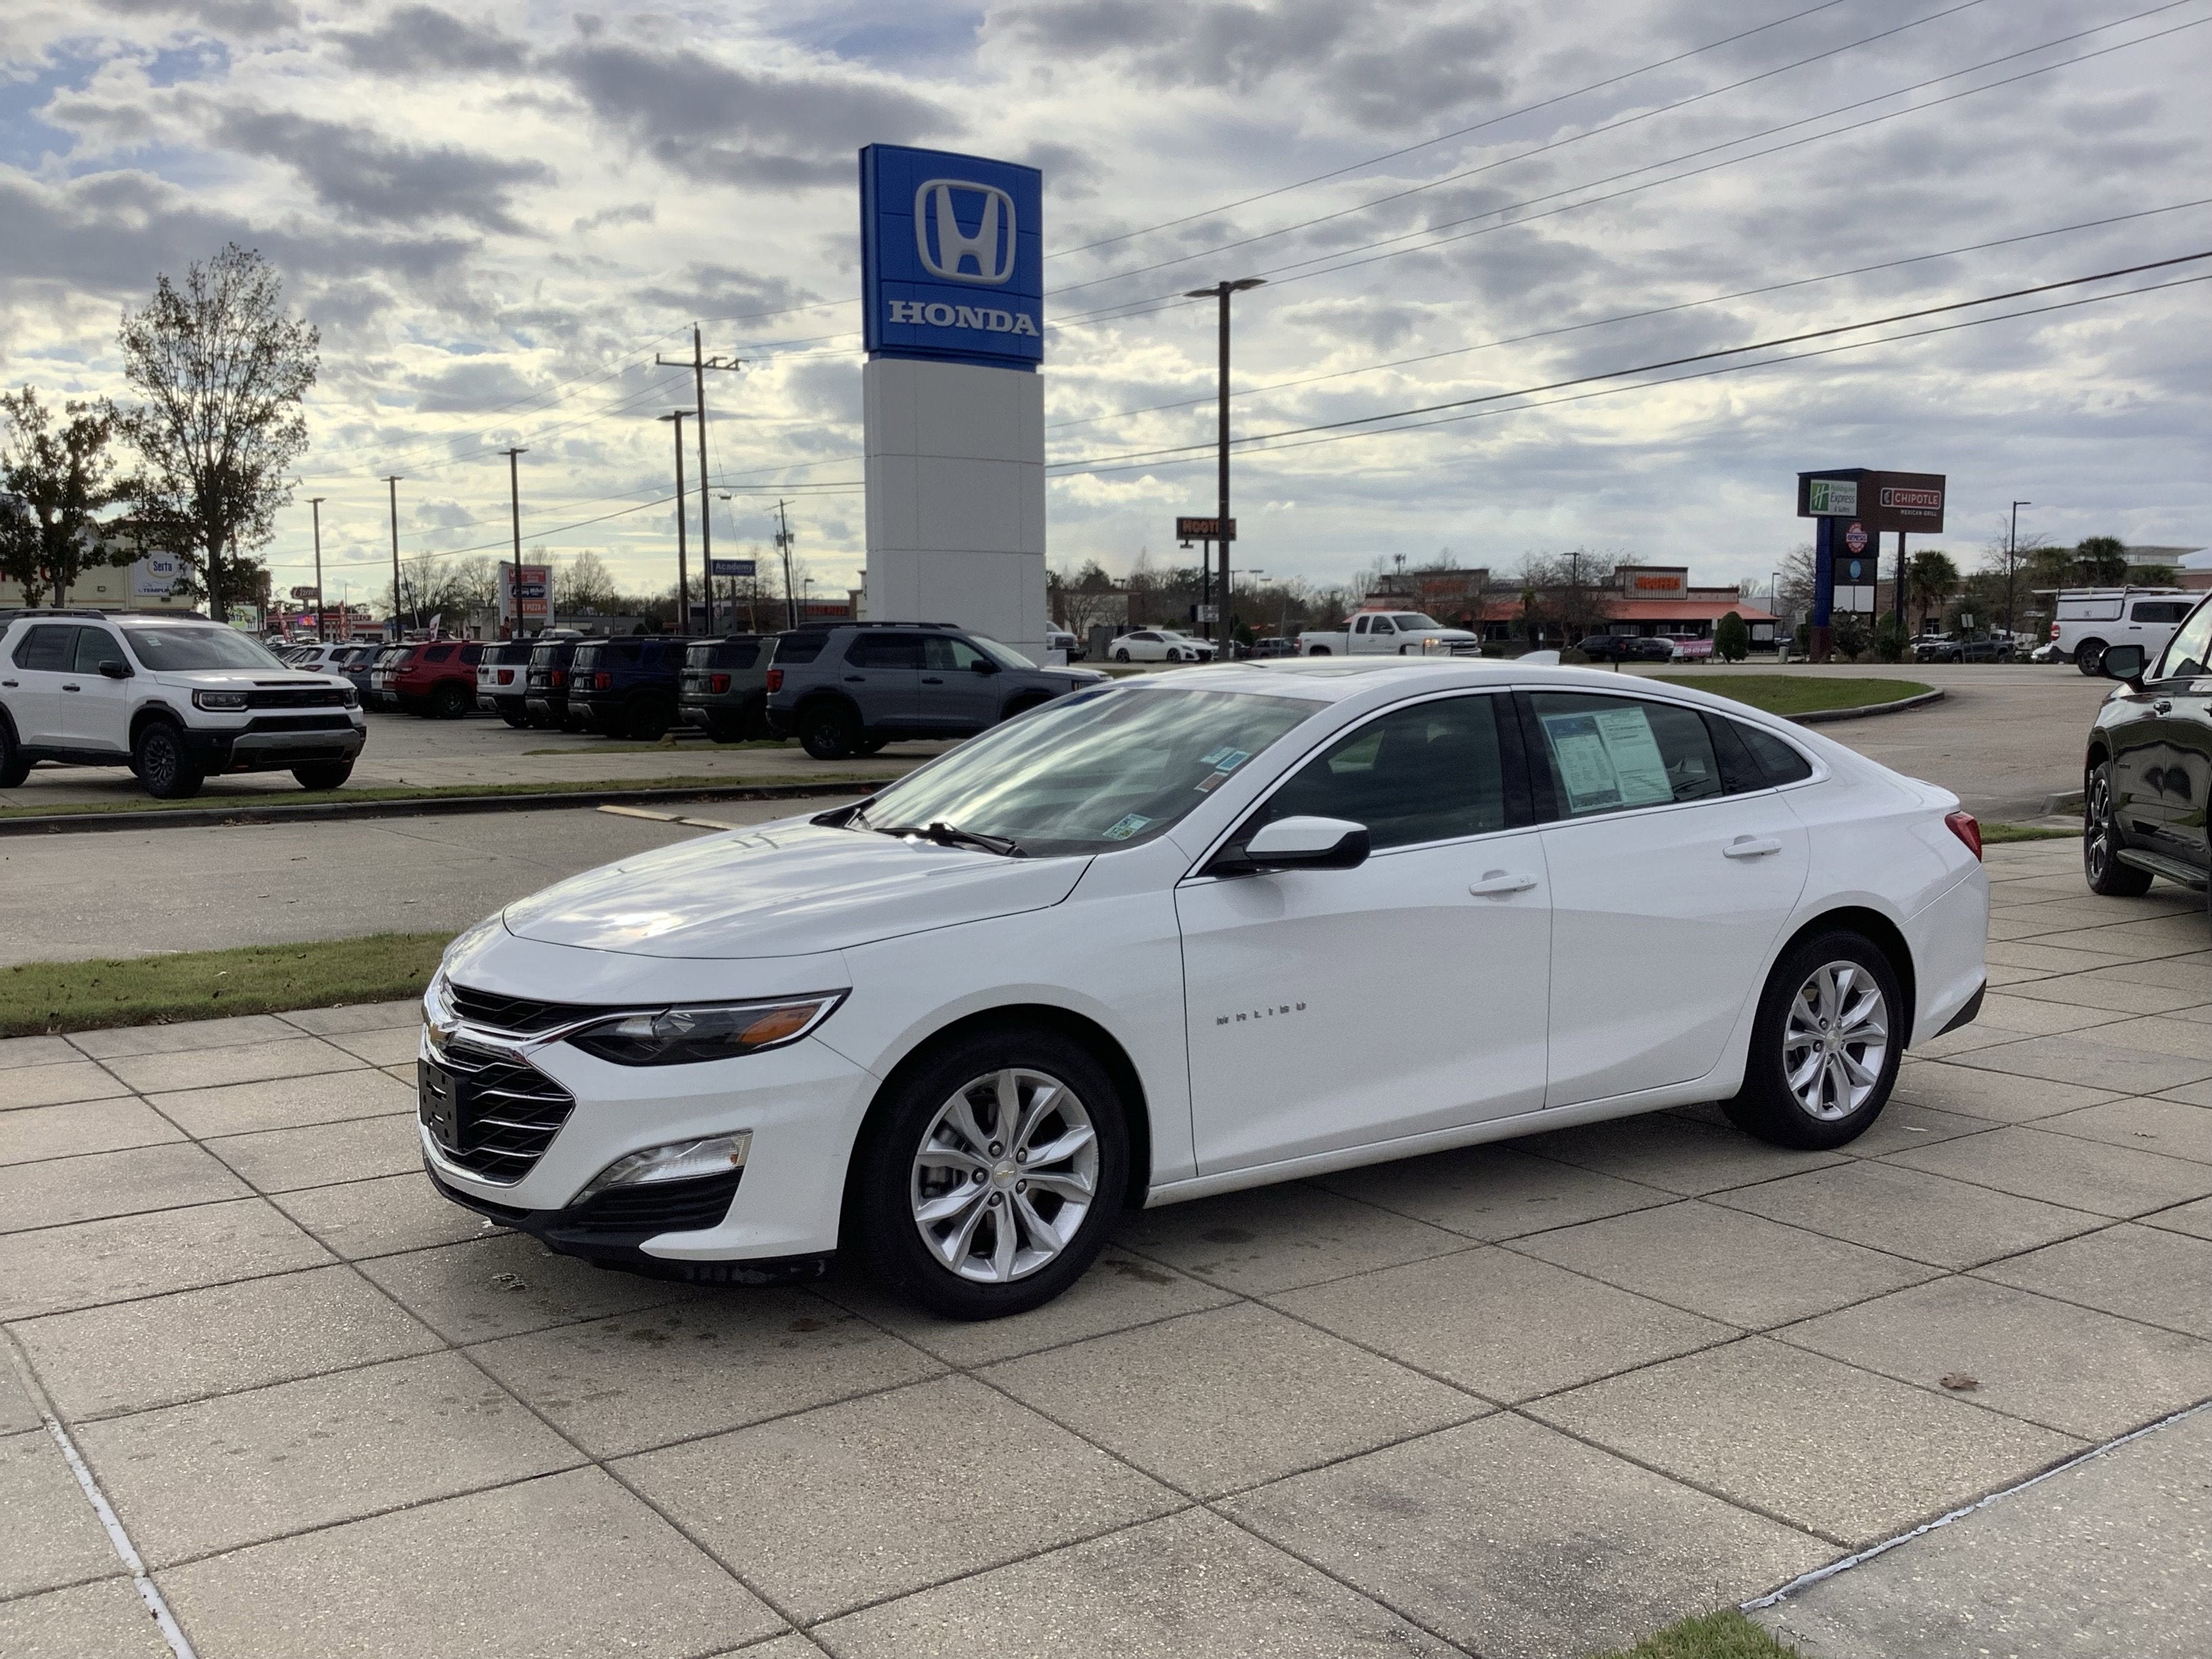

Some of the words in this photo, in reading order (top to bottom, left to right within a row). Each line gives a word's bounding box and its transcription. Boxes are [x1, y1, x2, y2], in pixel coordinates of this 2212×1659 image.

[888, 300, 1040, 337] HONDA
[1830, 493, 1855, 504] Express
[1895, 493, 1938, 504] CHIPOTLE
[1183, 519, 1235, 534] HOOTS
[153, 561, 172, 571] Serta
[716, 562, 753, 573] Academy
[527, 603, 541, 611] PIZZA
[1216, 1001, 1307, 1025] MALIBU
